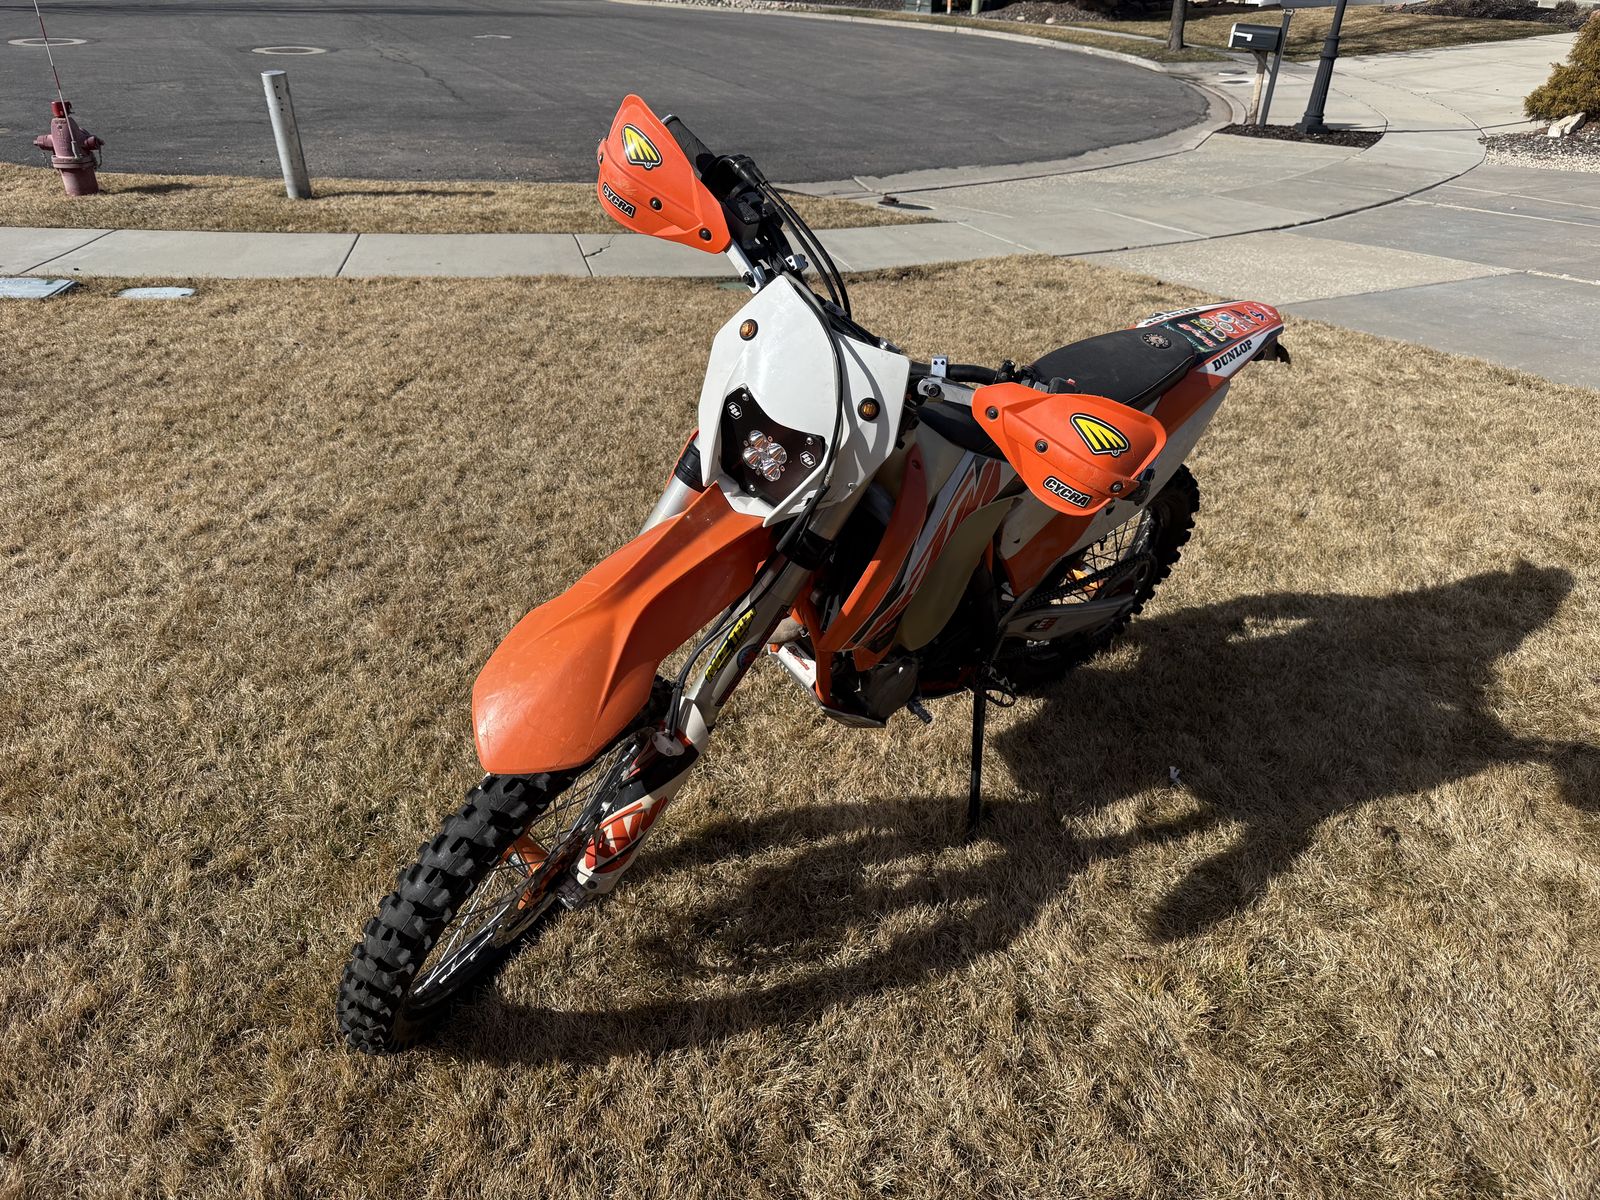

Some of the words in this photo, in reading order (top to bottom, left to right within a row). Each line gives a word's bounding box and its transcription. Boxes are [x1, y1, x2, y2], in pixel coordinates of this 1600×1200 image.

[602, 183, 635, 217] CYCRA
[1212, 339, 1253, 372] DUNLOP
[1045, 476, 1090, 508] CYCRA
